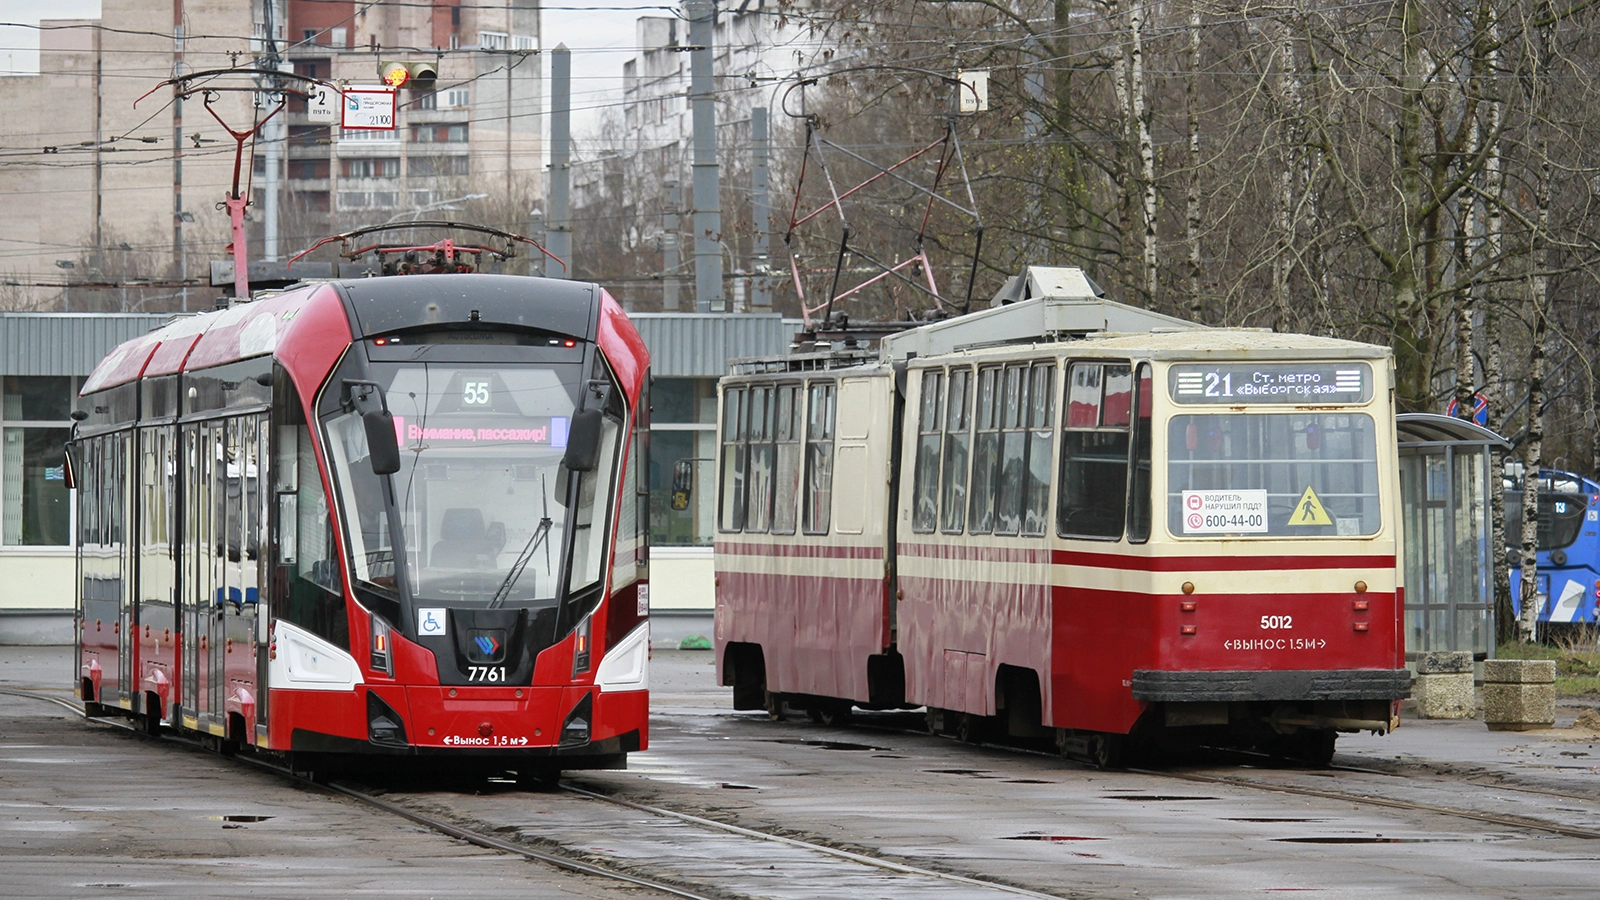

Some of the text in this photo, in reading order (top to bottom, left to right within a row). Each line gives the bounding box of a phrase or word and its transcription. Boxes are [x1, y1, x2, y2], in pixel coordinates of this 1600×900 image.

[319, 91, 325, 105] 2
[1253, 372, 1321, 384] Ст. метро
[1205, 372, 1234, 397] 21
[464, 382, 489, 404] 55
[408, 425, 547, 442] Внимание, пассажир!
[1205, 494, 1241, 502] ВОДИТЕЛЬ
[1243, 502, 1262, 511] ПДД?
[1555, 502, 1566, 514] 13
[1206, 515, 1262, 526] 600-44-00
[1260, 615, 1293, 629] 5012
[1233, 639, 1286, 650] ВЫНОС
[468, 667, 505, 681] 7761
[453, 735, 490, 745] Вынос
[493, 735, 508, 747] 1,5
